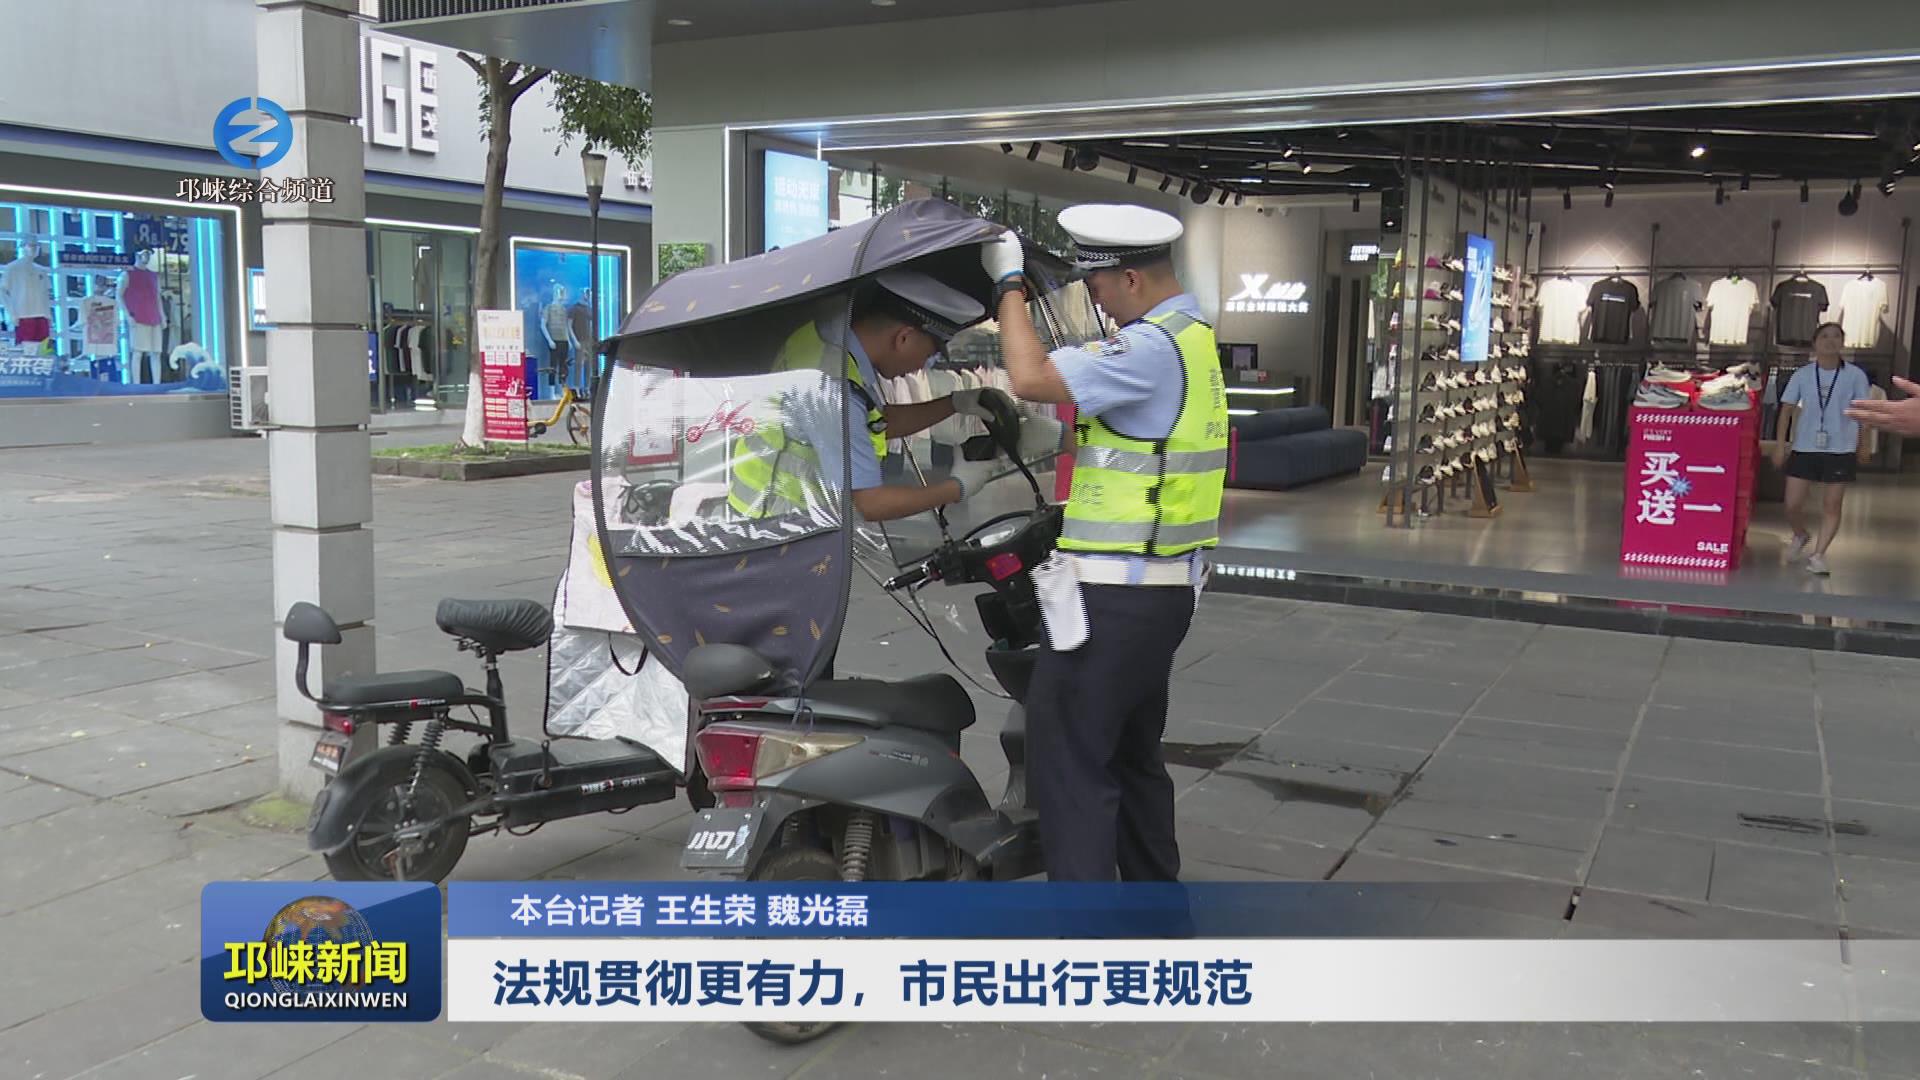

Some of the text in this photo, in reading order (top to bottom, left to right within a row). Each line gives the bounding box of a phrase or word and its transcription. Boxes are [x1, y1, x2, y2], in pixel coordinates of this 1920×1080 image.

[1640, 451, 1725, 486] 买一
[1636, 488, 1722, 525] 送一
[1697, 542, 1728, 553] SALE
